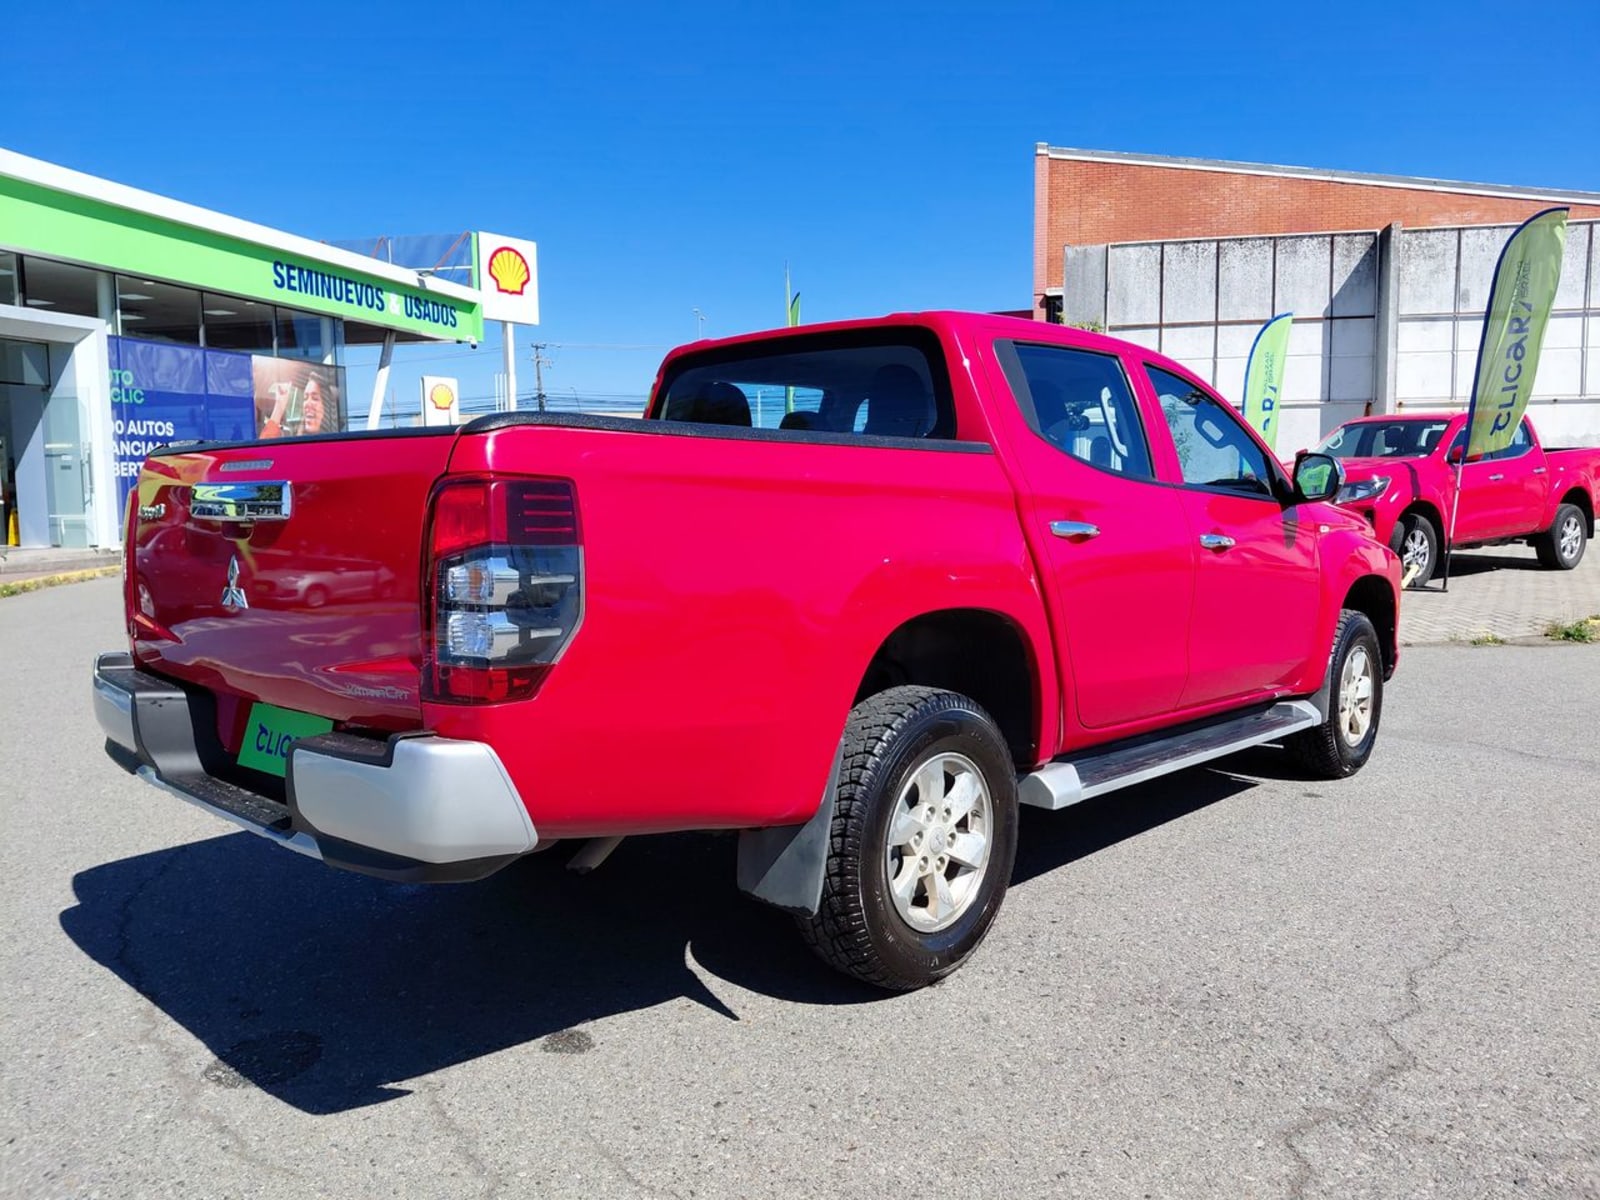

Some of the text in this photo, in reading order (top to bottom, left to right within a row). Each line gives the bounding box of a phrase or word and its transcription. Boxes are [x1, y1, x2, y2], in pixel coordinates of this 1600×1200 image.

[273, 261, 385, 312] SEMINUEVOS
[403, 294, 457, 328] USADOS
[127, 420, 175, 437] AUTOS
